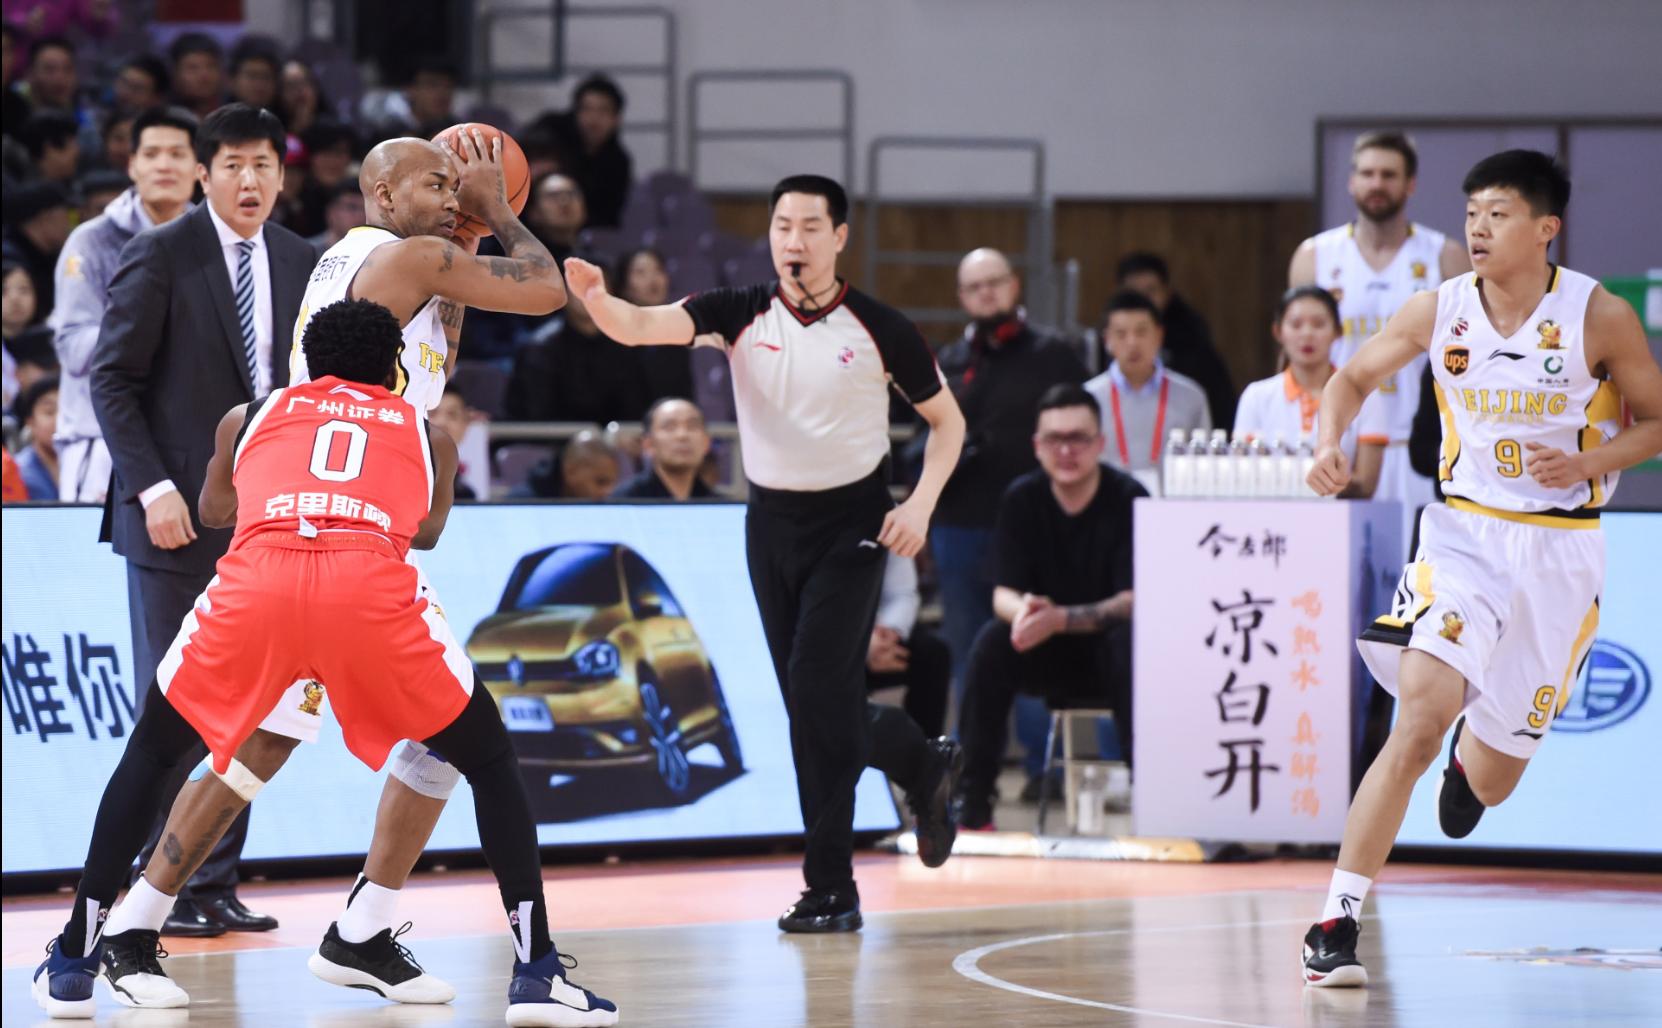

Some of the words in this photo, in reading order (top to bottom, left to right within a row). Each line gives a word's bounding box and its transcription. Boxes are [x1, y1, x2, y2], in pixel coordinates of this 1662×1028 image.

[1444, 350, 1468, 374] ups
[286, 396, 405, 425] 广州证券
[1450, 386, 1568, 416] EIJING
[308, 418, 369, 483] 0
[1494, 438, 1523, 478] 9
[2, 632, 136, 744] 唯你
[1203, 589, 1280, 814] 凉白开
[1527, 685, 1556, 730] 9
